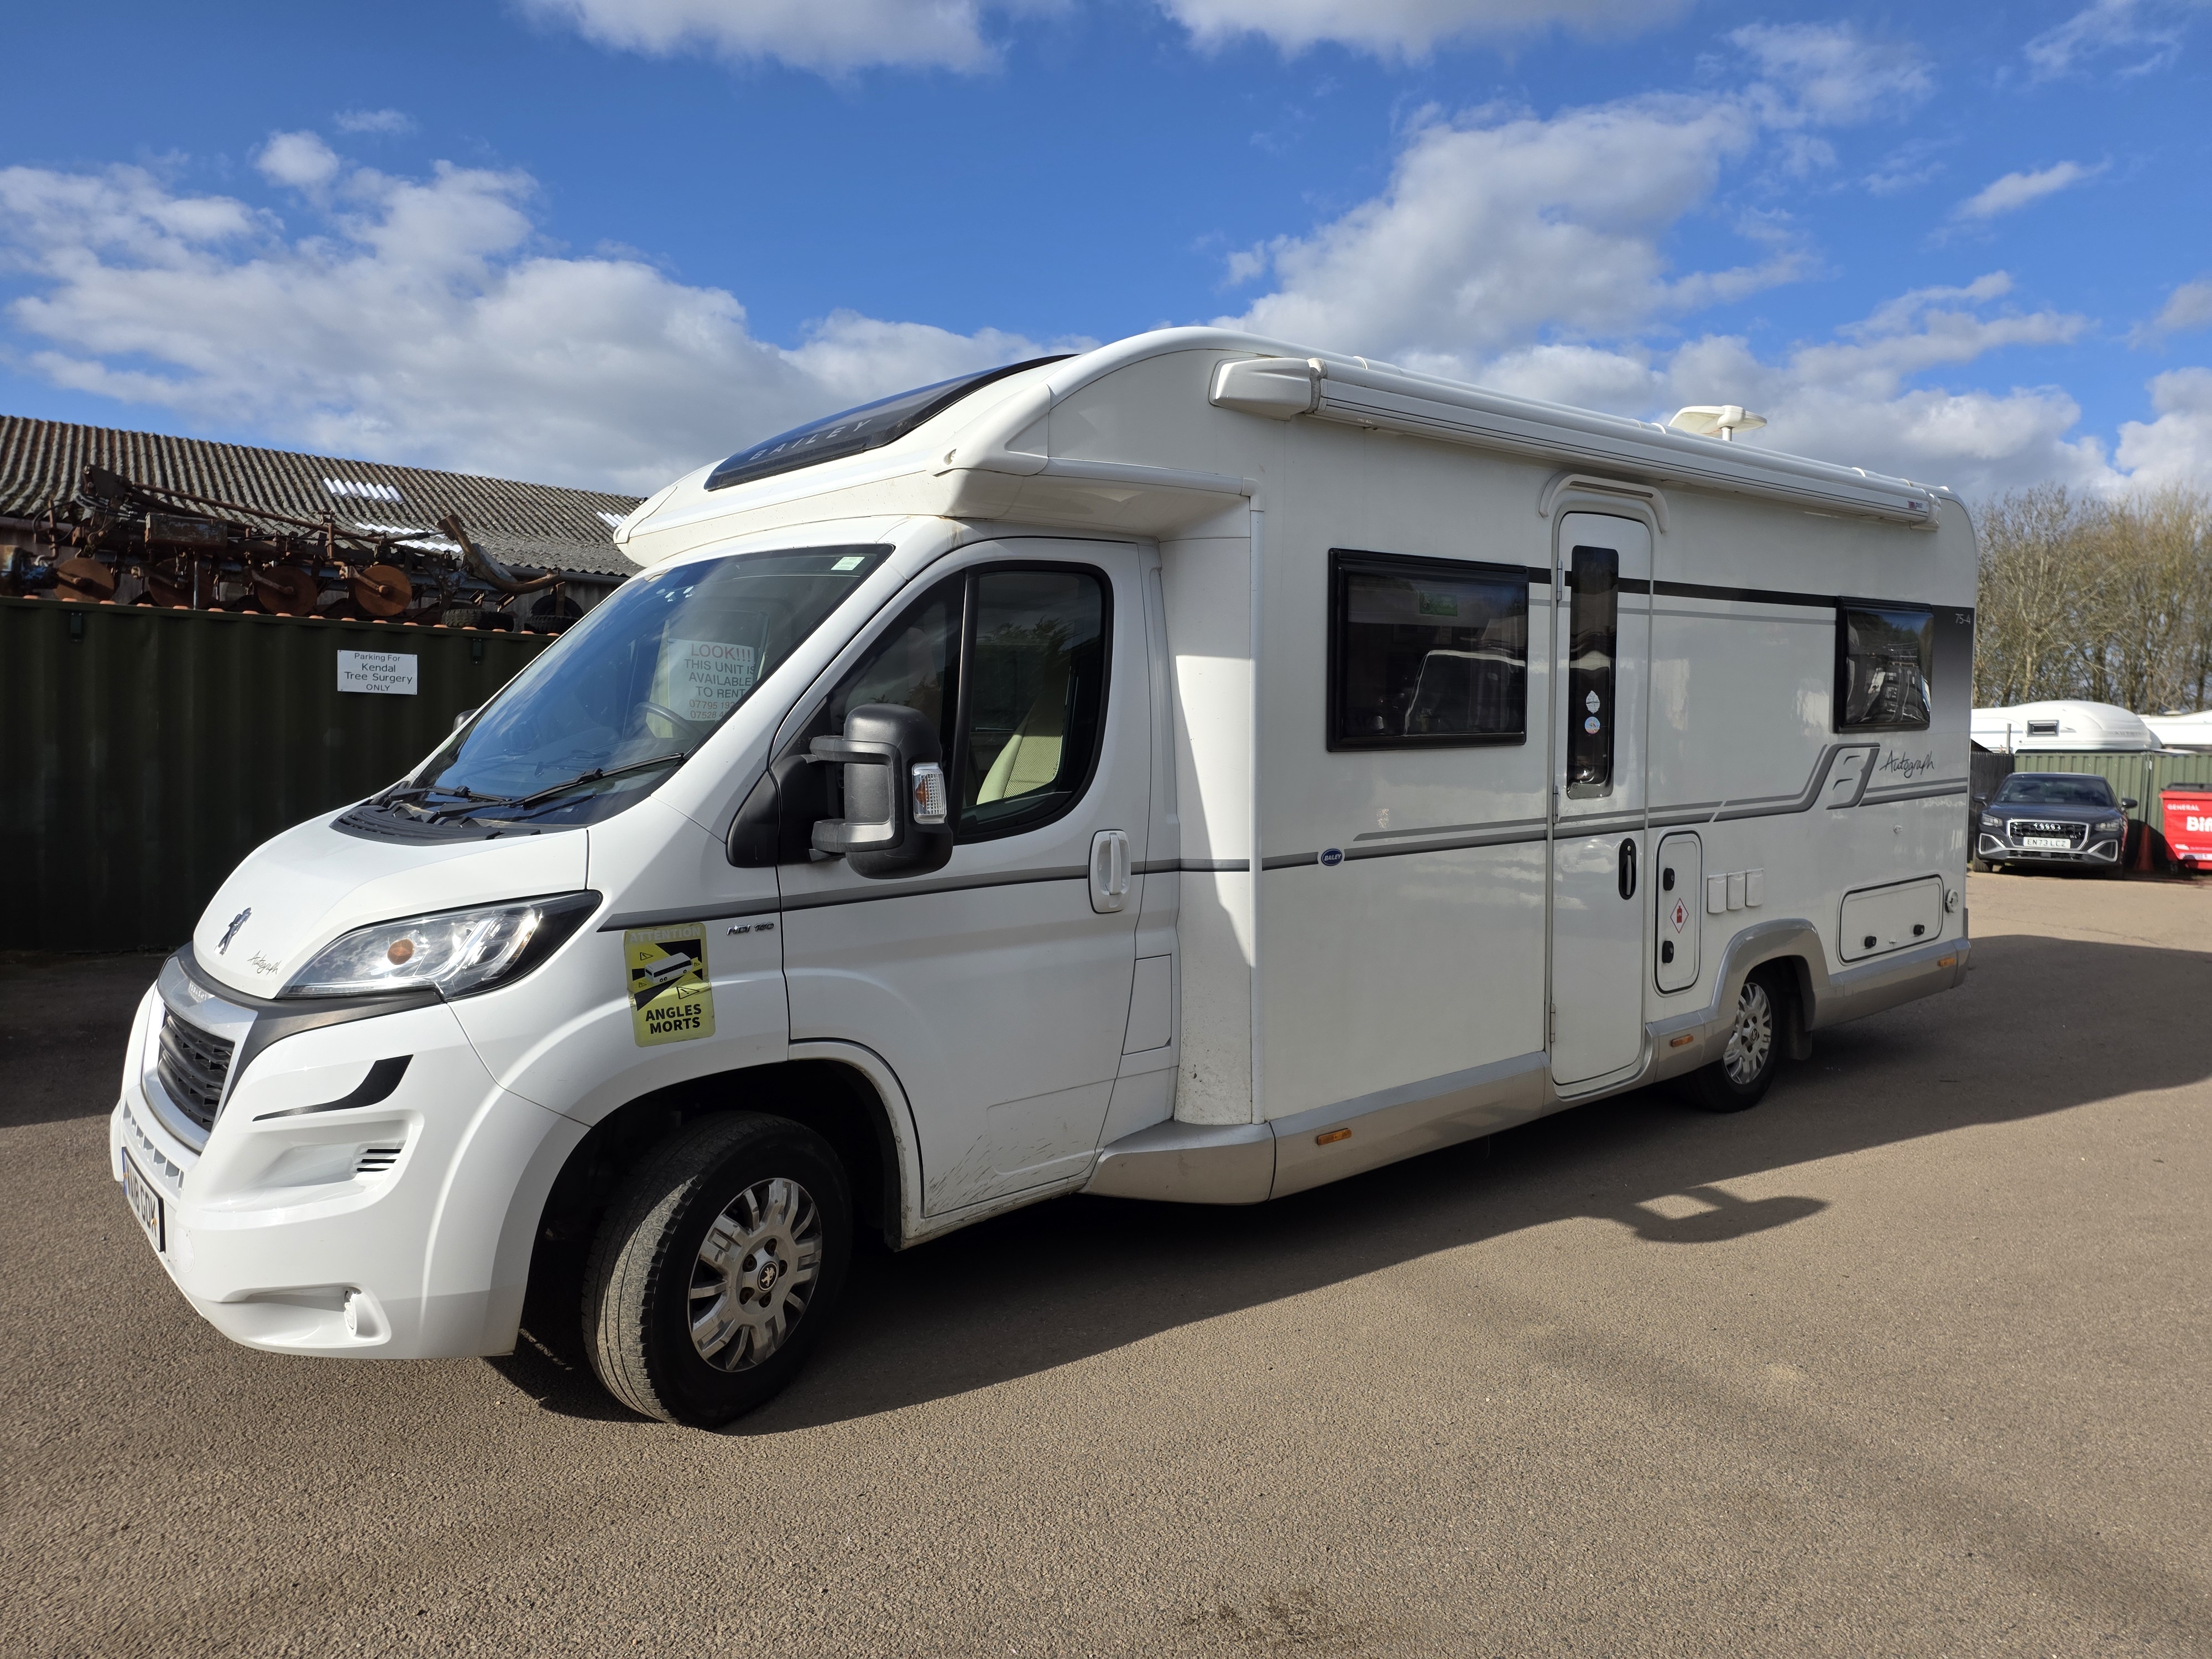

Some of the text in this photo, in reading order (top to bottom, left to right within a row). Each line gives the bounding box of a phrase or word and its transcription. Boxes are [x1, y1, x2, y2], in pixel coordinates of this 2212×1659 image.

[748, 419, 872, 461] BAILEY
[354, 653, 385, 662] Parking
[691, 643, 750, 662] LOOK!!!
[362, 663, 395, 672] Kendal
[684, 659, 755, 675] THIS UNIT IS
[345, 671, 413, 684] Tree Surgery
[688, 672, 751, 686] AVAILABLE
[695, 686, 745, 698] TO RENT
[689, 699, 718, 709] 07795
[690, 710, 717, 719] 07528
[1880, 749, 1935, 779] Autograph
[2187, 816, 2212, 832] Bif
[629, 926, 701, 942] ATTENTION
[754, 921, 774, 932] 160
[247, 950, 282, 975] Autograph
[645, 1003, 702, 1021] ANGLES
[650, 1016, 701, 1034] MORTS
